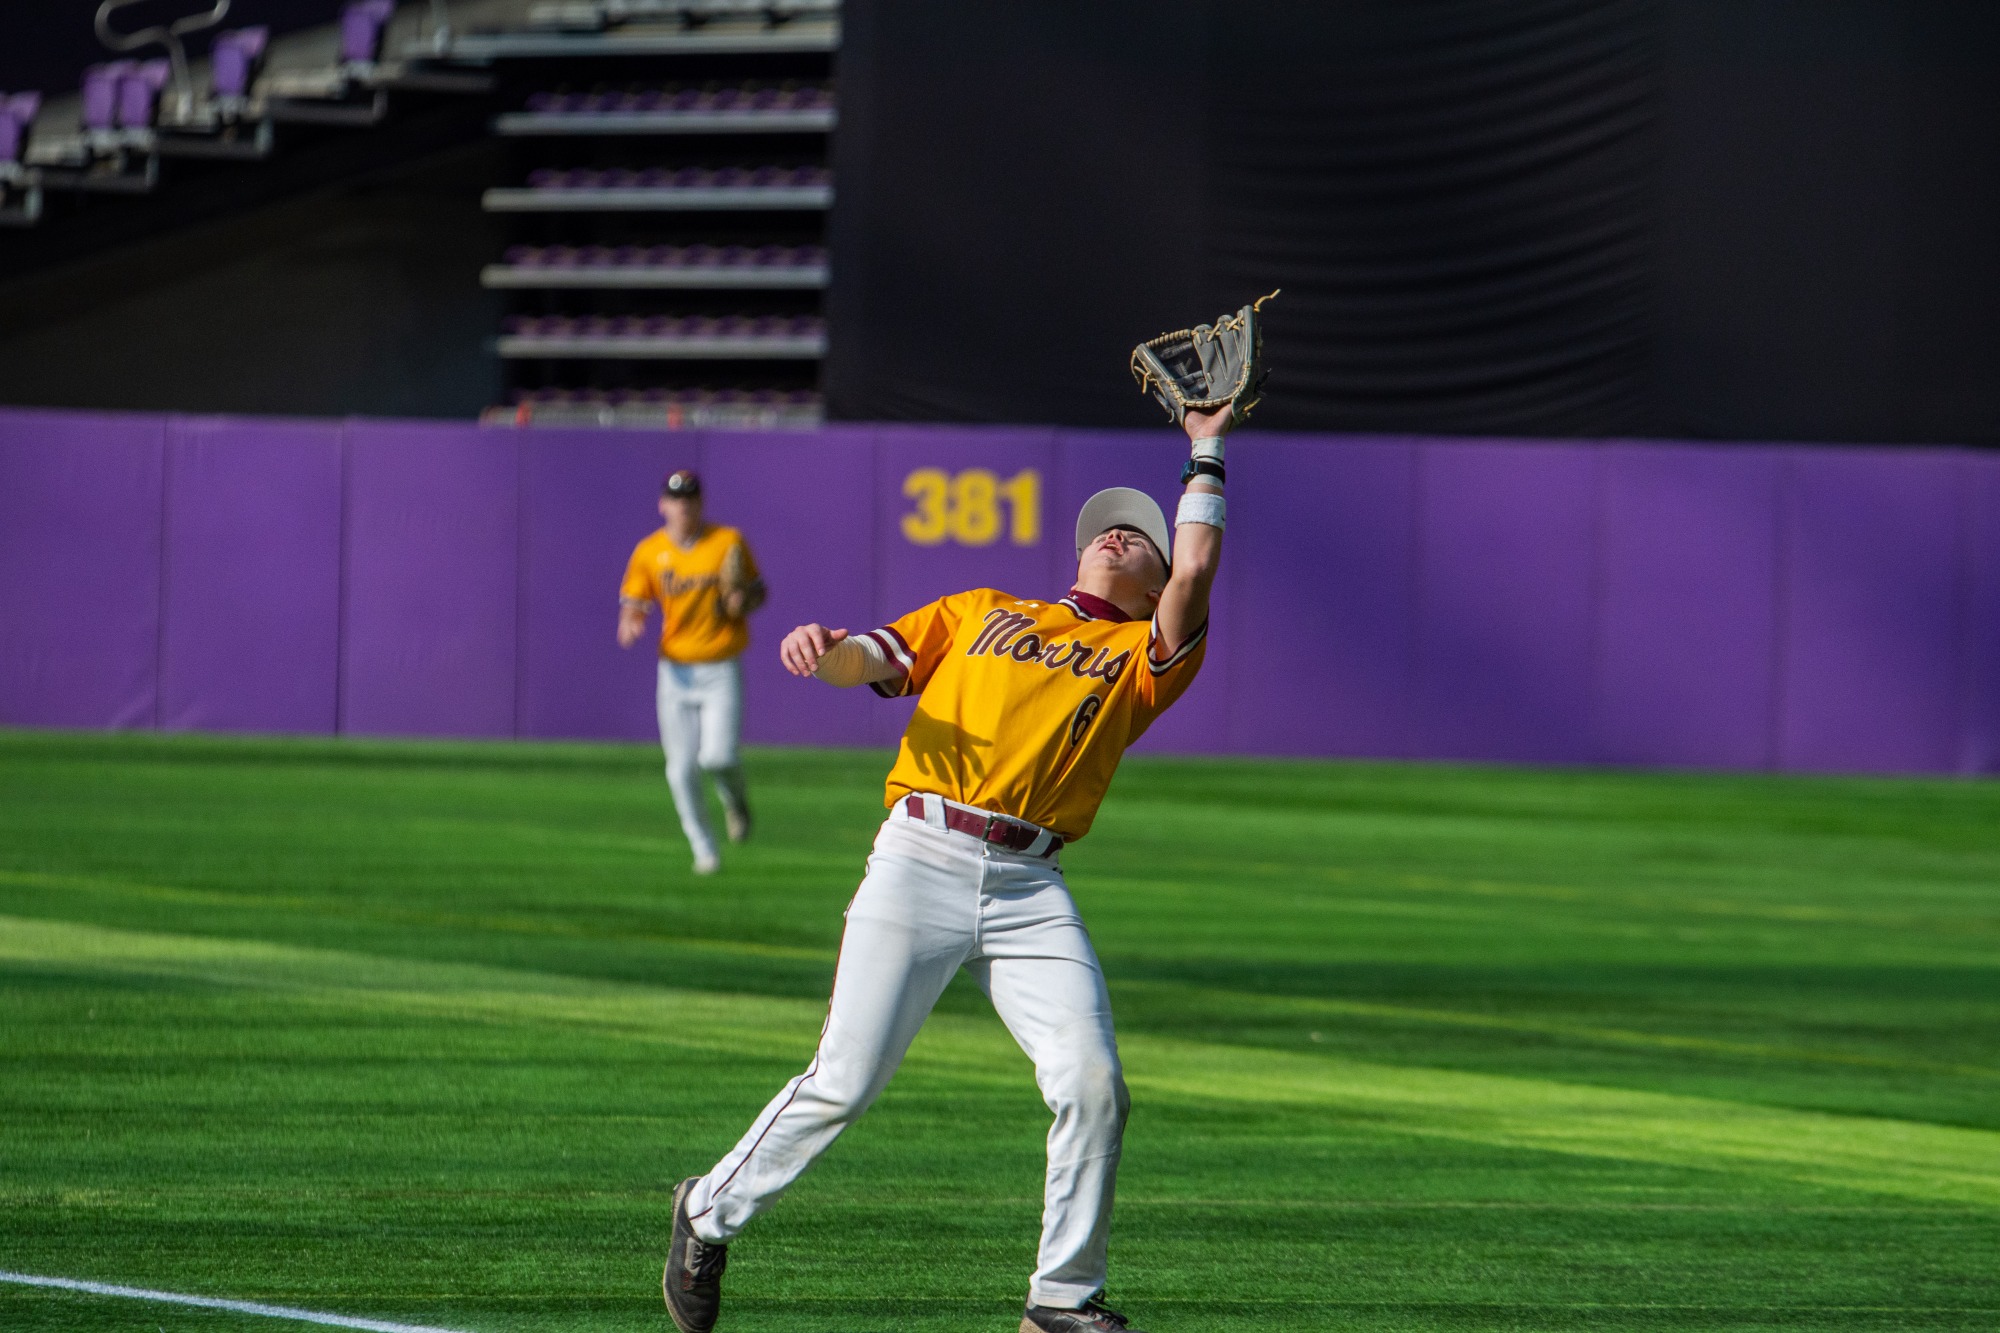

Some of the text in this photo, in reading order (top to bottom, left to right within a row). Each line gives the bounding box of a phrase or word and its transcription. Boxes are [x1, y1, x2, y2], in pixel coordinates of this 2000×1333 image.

[903, 469, 1041, 545] 381
[966, 608, 1132, 685] Morris
[1070, 694, 1101, 748] 6
